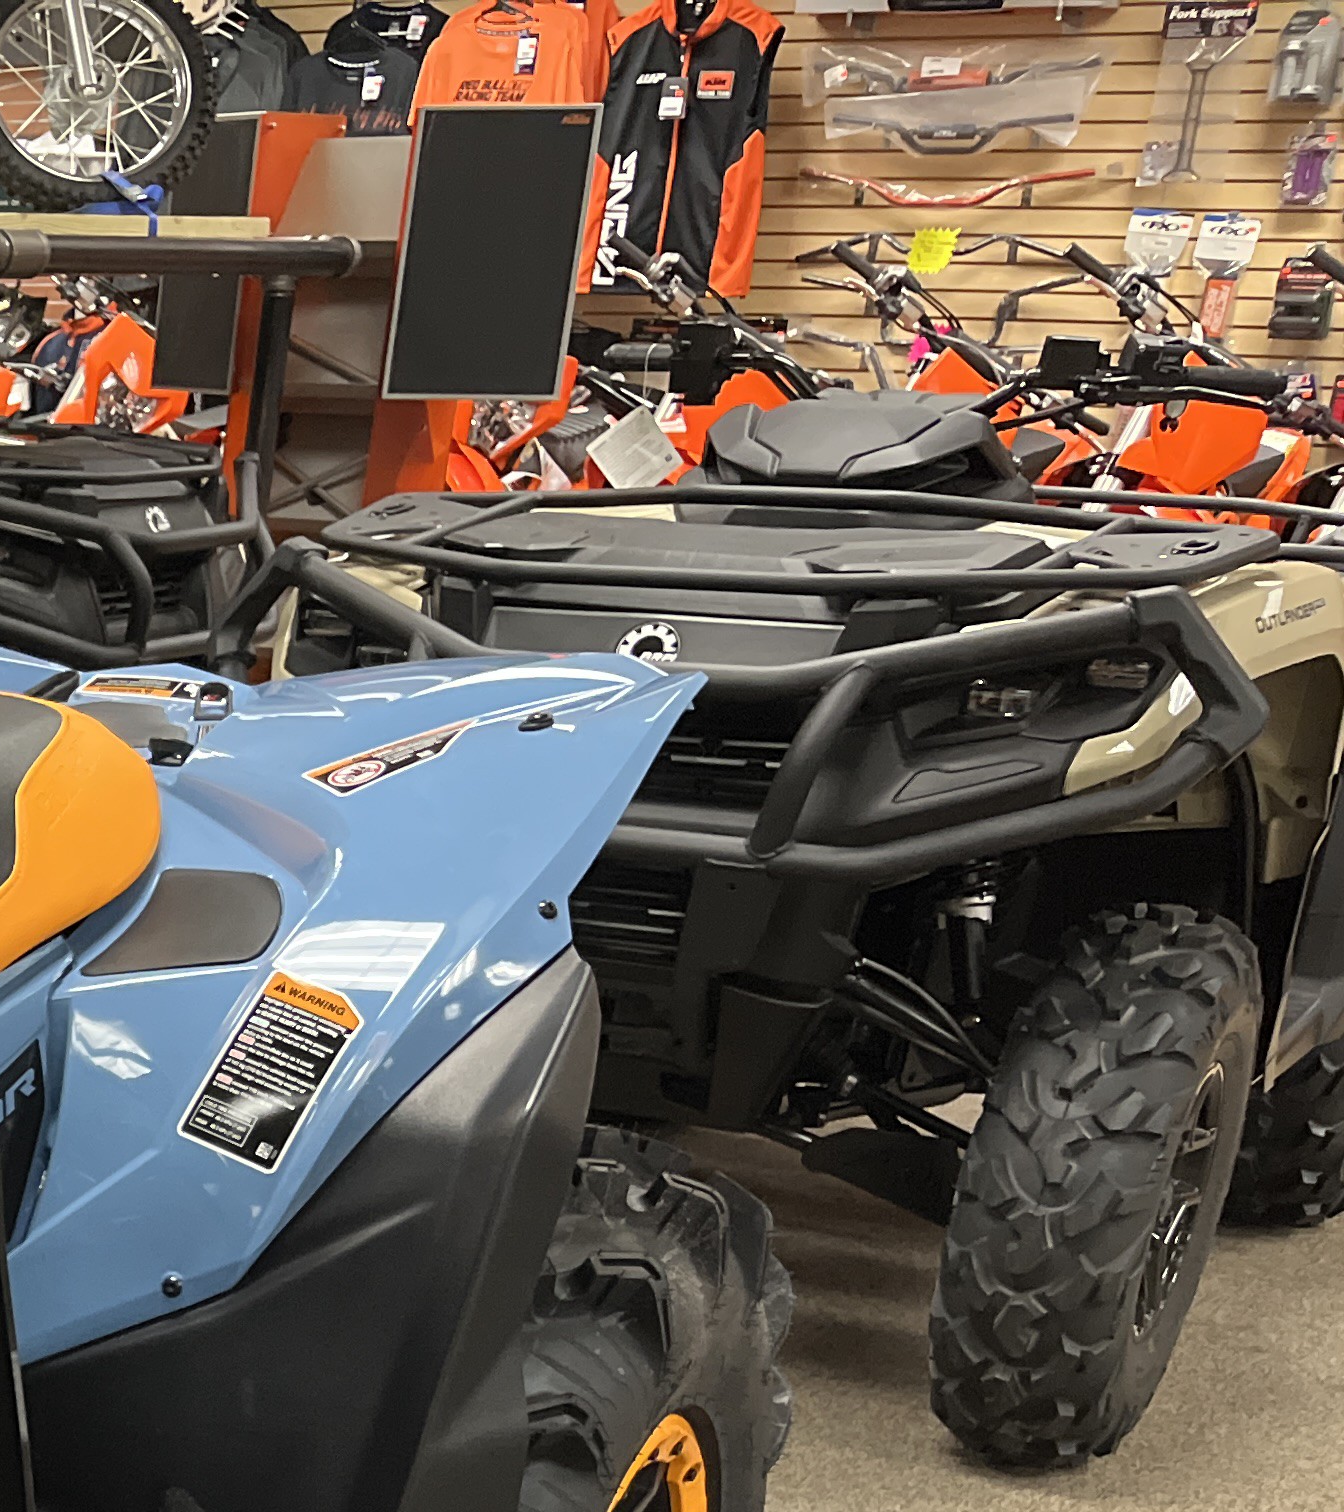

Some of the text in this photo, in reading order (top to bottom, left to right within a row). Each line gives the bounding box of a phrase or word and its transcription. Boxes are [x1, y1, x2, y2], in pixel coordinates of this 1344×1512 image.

[1169, 5, 1253, 19] Fork Support
[494, 91, 526, 101] TEAM
[288, 985, 346, 1017] WARNING
